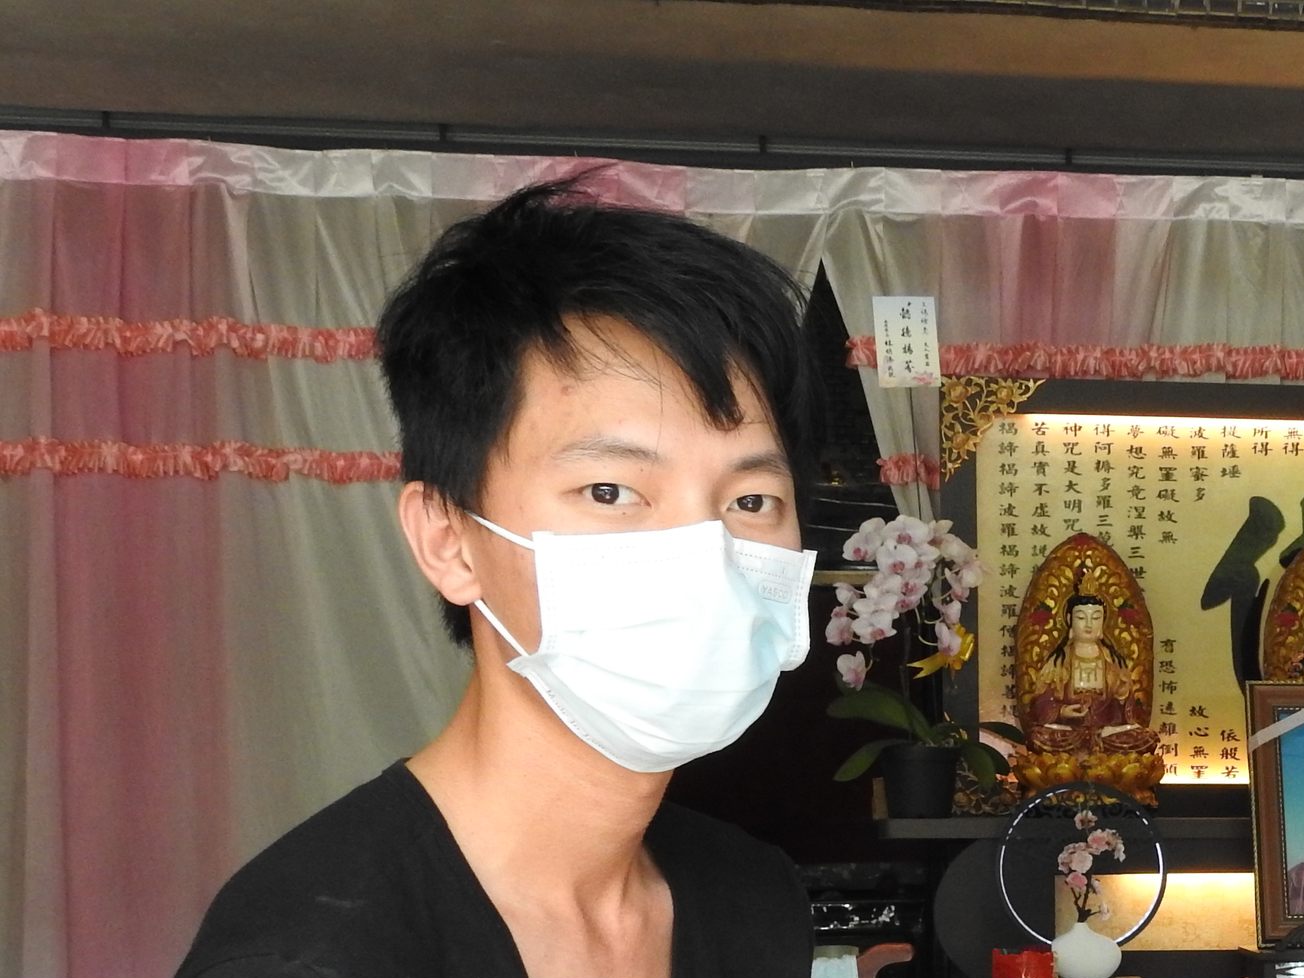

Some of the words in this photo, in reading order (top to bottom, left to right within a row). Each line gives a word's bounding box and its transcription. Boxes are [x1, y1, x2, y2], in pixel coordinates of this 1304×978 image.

[1252, 427, 1273, 457] 所得
[1283, 428, 1304, 457] 無得
[1190, 427, 1208, 502] 波羅蜜多
